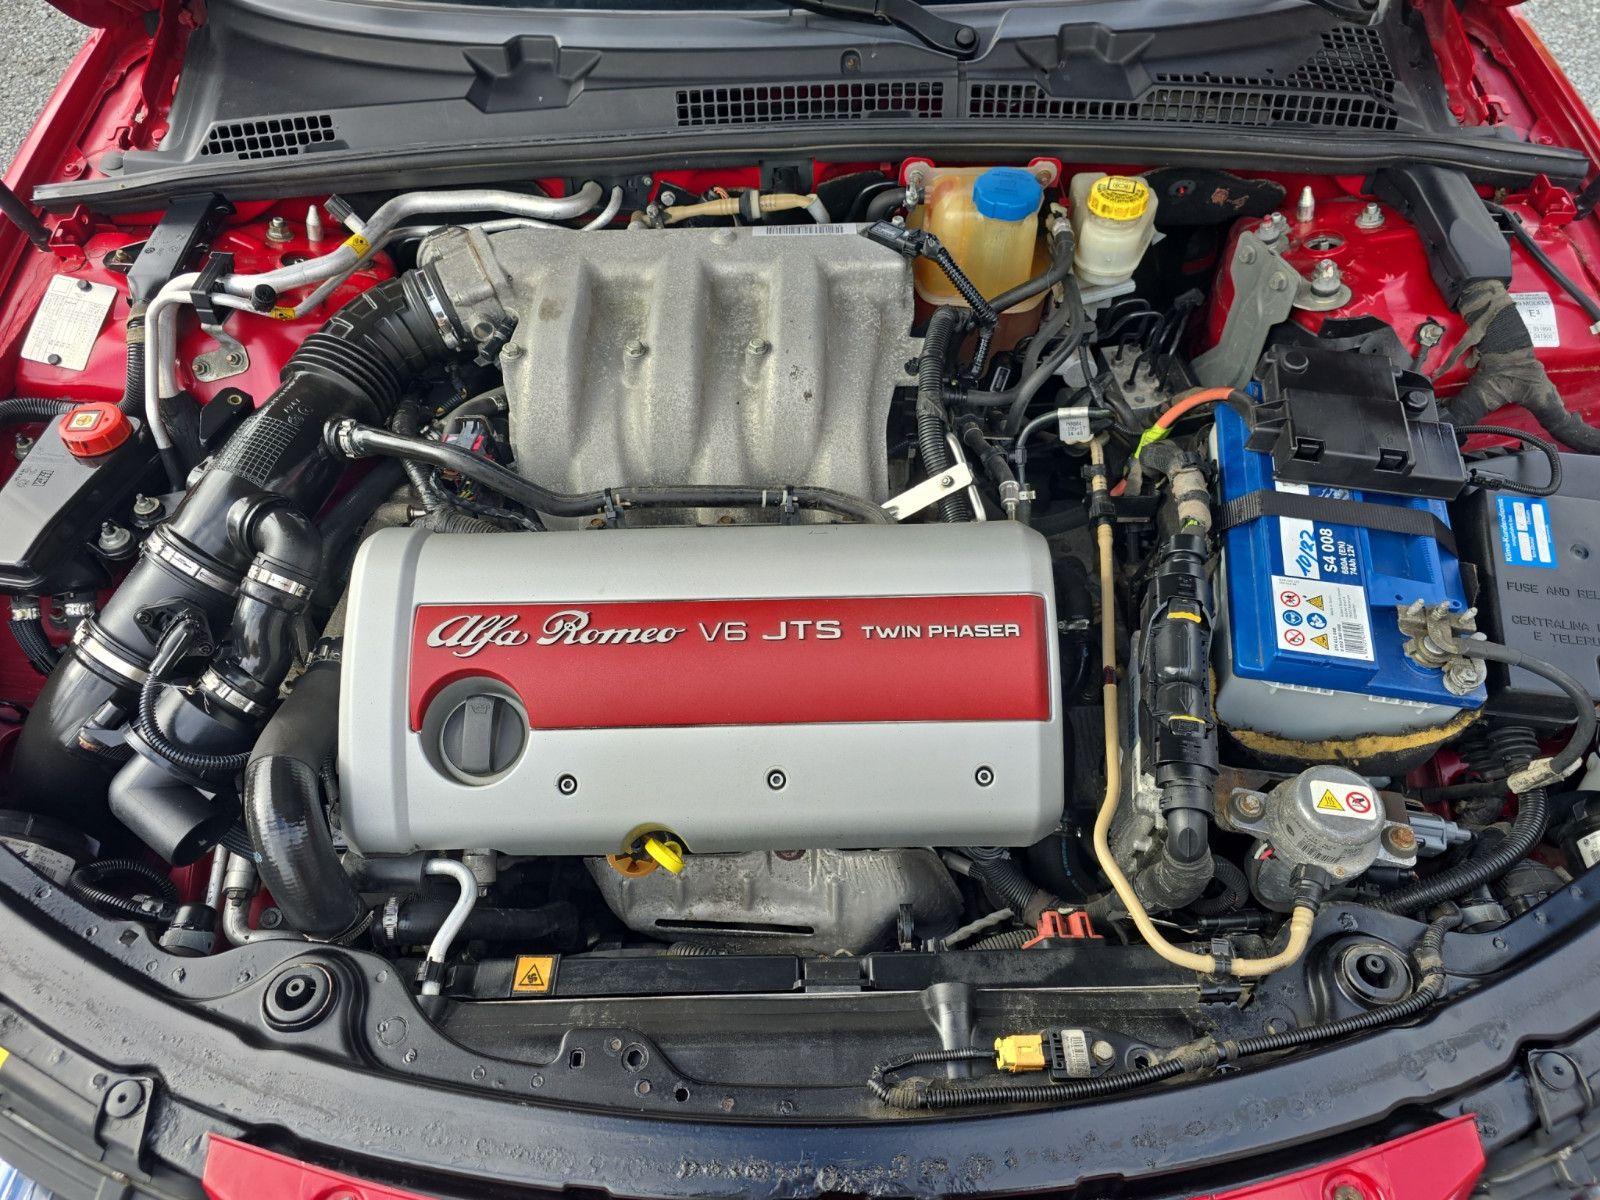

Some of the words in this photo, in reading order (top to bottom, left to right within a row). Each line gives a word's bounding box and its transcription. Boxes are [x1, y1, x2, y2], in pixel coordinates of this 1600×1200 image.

[1320, 528, 1335, 552] 008
[1337, 541, 1348, 556] (EN)
[1346, 544, 1356, 557] 12V
[1323, 556, 1338, 573] S4
[1348, 559, 1358, 575] 74Ah
[1506, 581, 1539, 594] FUSE
[1546, 586, 1570, 597] AND
[1511, 615, 1590, 632] CENTRALINA
[426, 614, 530, 658] Alfa
[536, 610, 688, 645] Romeo
[699, 621, 748, 642] V6
[762, 620, 842, 640] JTS
[861, 624, 921, 639] TWIN
[928, 623, 1021, 638] PHASER
[1533, 631, 1543, 642] E
